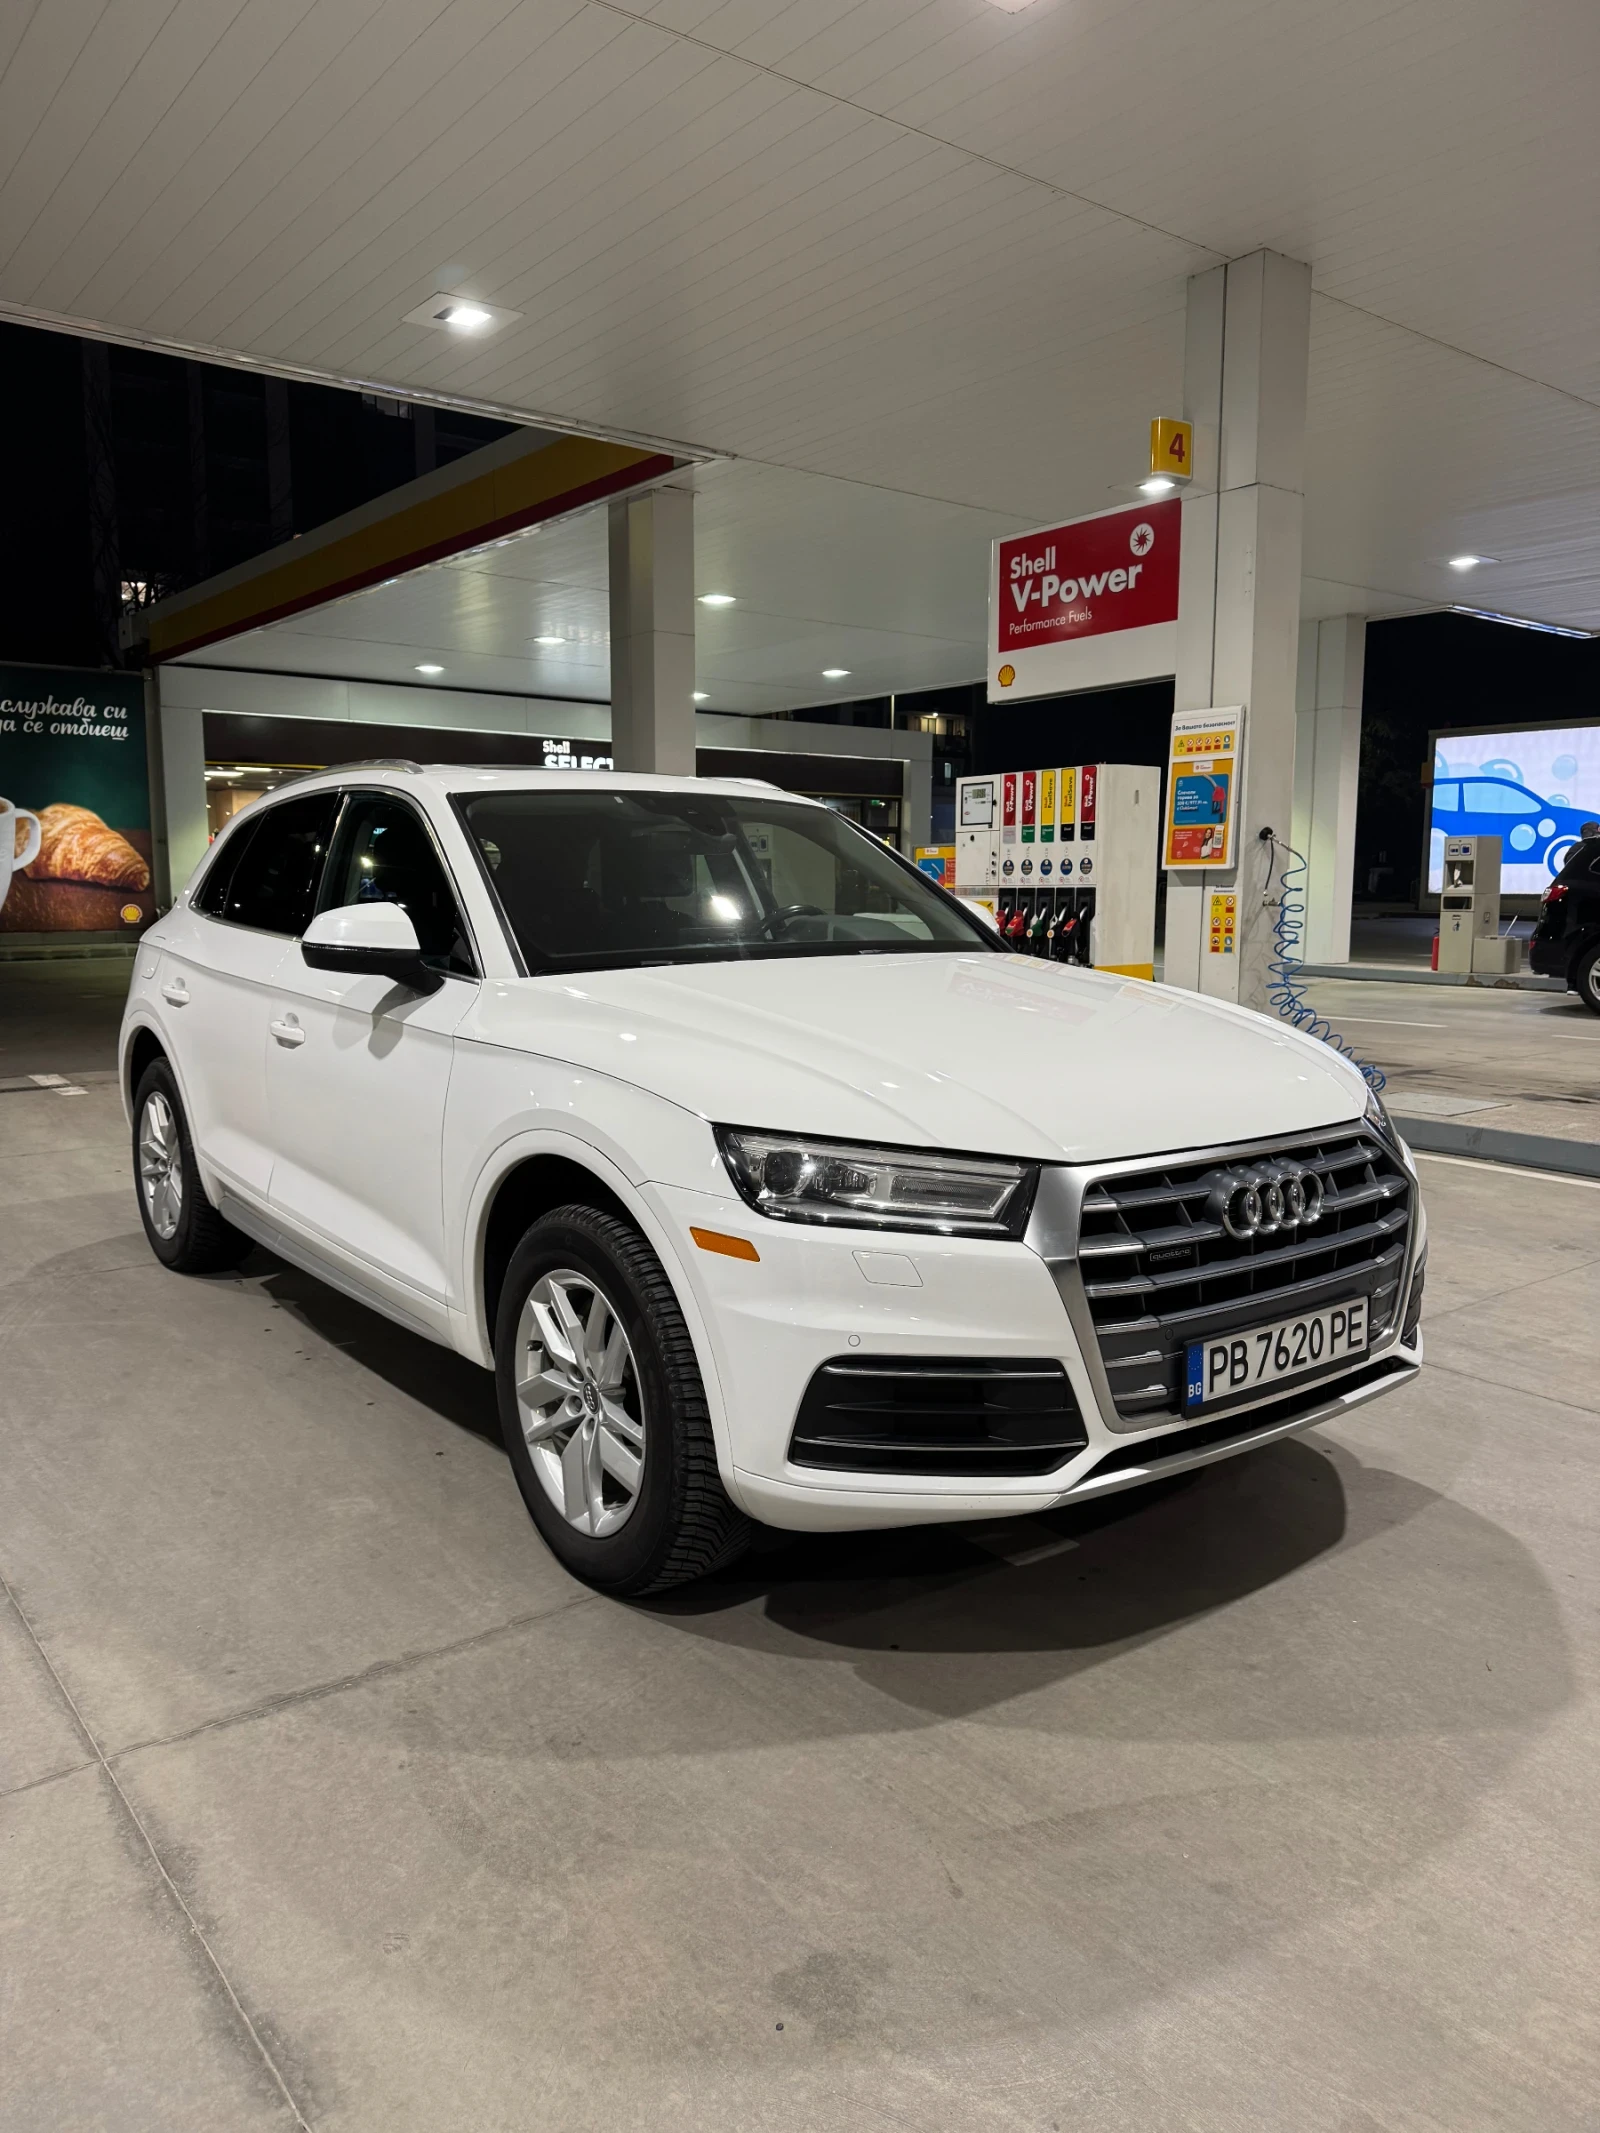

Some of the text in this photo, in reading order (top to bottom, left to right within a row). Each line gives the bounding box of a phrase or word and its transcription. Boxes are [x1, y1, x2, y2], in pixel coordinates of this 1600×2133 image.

[1169, 432, 1185, 463] 4
[1010, 545, 1056, 579] Shell
[1010, 563, 1143, 613] V-Power
[1009, 606, 1093, 635] Performance Fuels
[0, 695, 127, 720] служава си
[0, 717, 129, 740] а се отбиеш
[543, 740, 570, 754] Shell
[1152, 1248, 1190, 1260] quattro
[1256, 1317, 1324, 1379] 7620
[1188, 1381, 1202, 1398] BG
